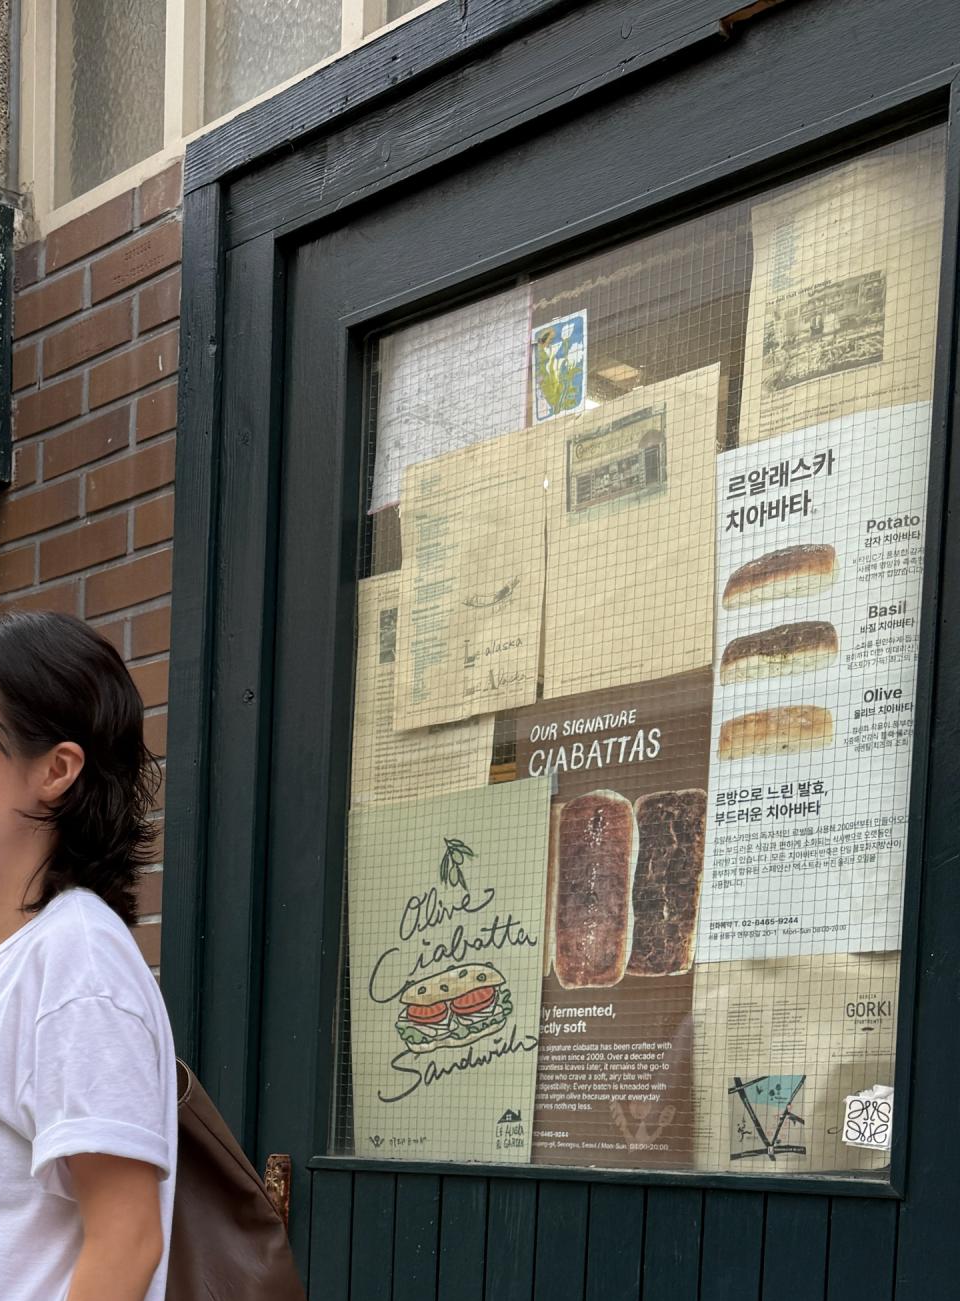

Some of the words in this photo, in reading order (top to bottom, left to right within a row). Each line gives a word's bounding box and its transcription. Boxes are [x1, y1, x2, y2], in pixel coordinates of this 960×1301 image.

[726, 449, 835, 500] 르알래스카
[726, 490, 812, 532] 치아바타
[866, 515, 920, 533] Potato
[864, 535, 880, 548] 감자
[884, 530, 920, 544] 치아바타
[868, 600, 906, 618] Basil
[860, 622, 876, 634] 바질
[878, 618, 915, 630] 치아바타
[864, 688, 902, 703] Olive
[854, 706, 876, 720] 올리브
[878, 702, 914, 714] 치아바타
[530, 723, 558, 743] OUR
[562, 708, 637, 736] SIGNATURE
[528, 728, 661, 776] CIABATTAS
[716, 788, 763, 806] 르방으로
[766, 784, 793, 800] 느린
[798, 780, 828, 797] 발효,
[714, 807, 762, 826] 부드러운
[766, 800, 821, 820] 치아바타
[400, 887, 495, 940] Olive
[369, 914, 538, 1004] Ciabatta
[552, 1004, 616, 1018] fermented,
[846, 1000, 891, 1018] GORKI
[563, 1020, 586, 1033] soft
[632, 1042, 656, 1050] crafted
[657, 1042, 672, 1050] with
[378, 1024, 538, 1103] Sandwich
[607, 1052, 623, 1060] Over
[630, 1052, 655, 1060] decade
[650, 1063, 670, 1072] go-to
[594, 1072, 608, 1081] soft,
[609, 1073, 622, 1082] airy
[573, 1082, 592, 1091] Every
[620, 1082, 650, 1090] kneaded
[650, 1082, 666, 1090] with
[554, 1103, 576, 1111] nothing
[578, 1102, 592, 1110] less.
[612, 1094, 626, 1102] your
[628, 1094, 660, 1102] everyday
